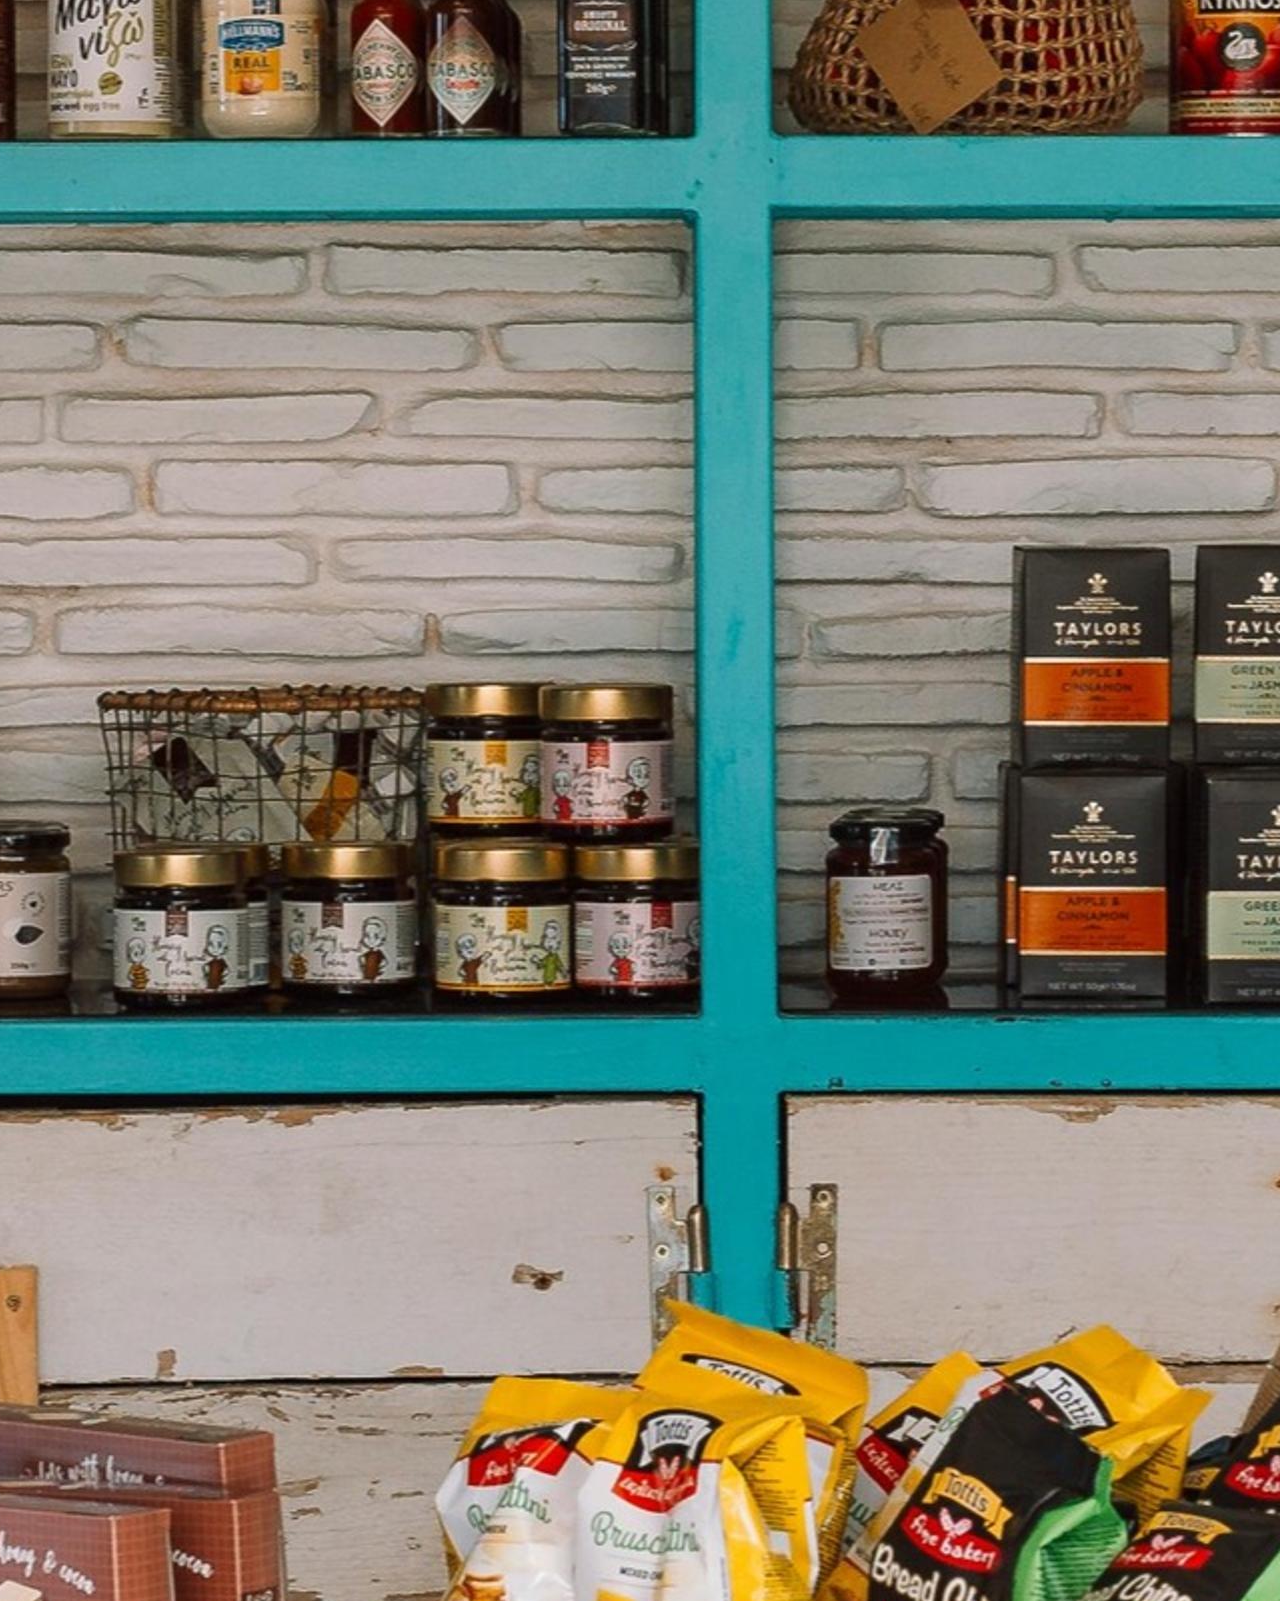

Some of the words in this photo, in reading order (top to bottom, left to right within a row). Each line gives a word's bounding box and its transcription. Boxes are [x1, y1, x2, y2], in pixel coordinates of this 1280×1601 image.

[232, 55, 271, 69] REAL
[1053, 621, 1142, 636] TAYLORS
[1231, 665, 1274, 676] GREEN
[1049, 850, 1139, 866] TAYLORS
[944, 1474, 991, 1513] Tottis
